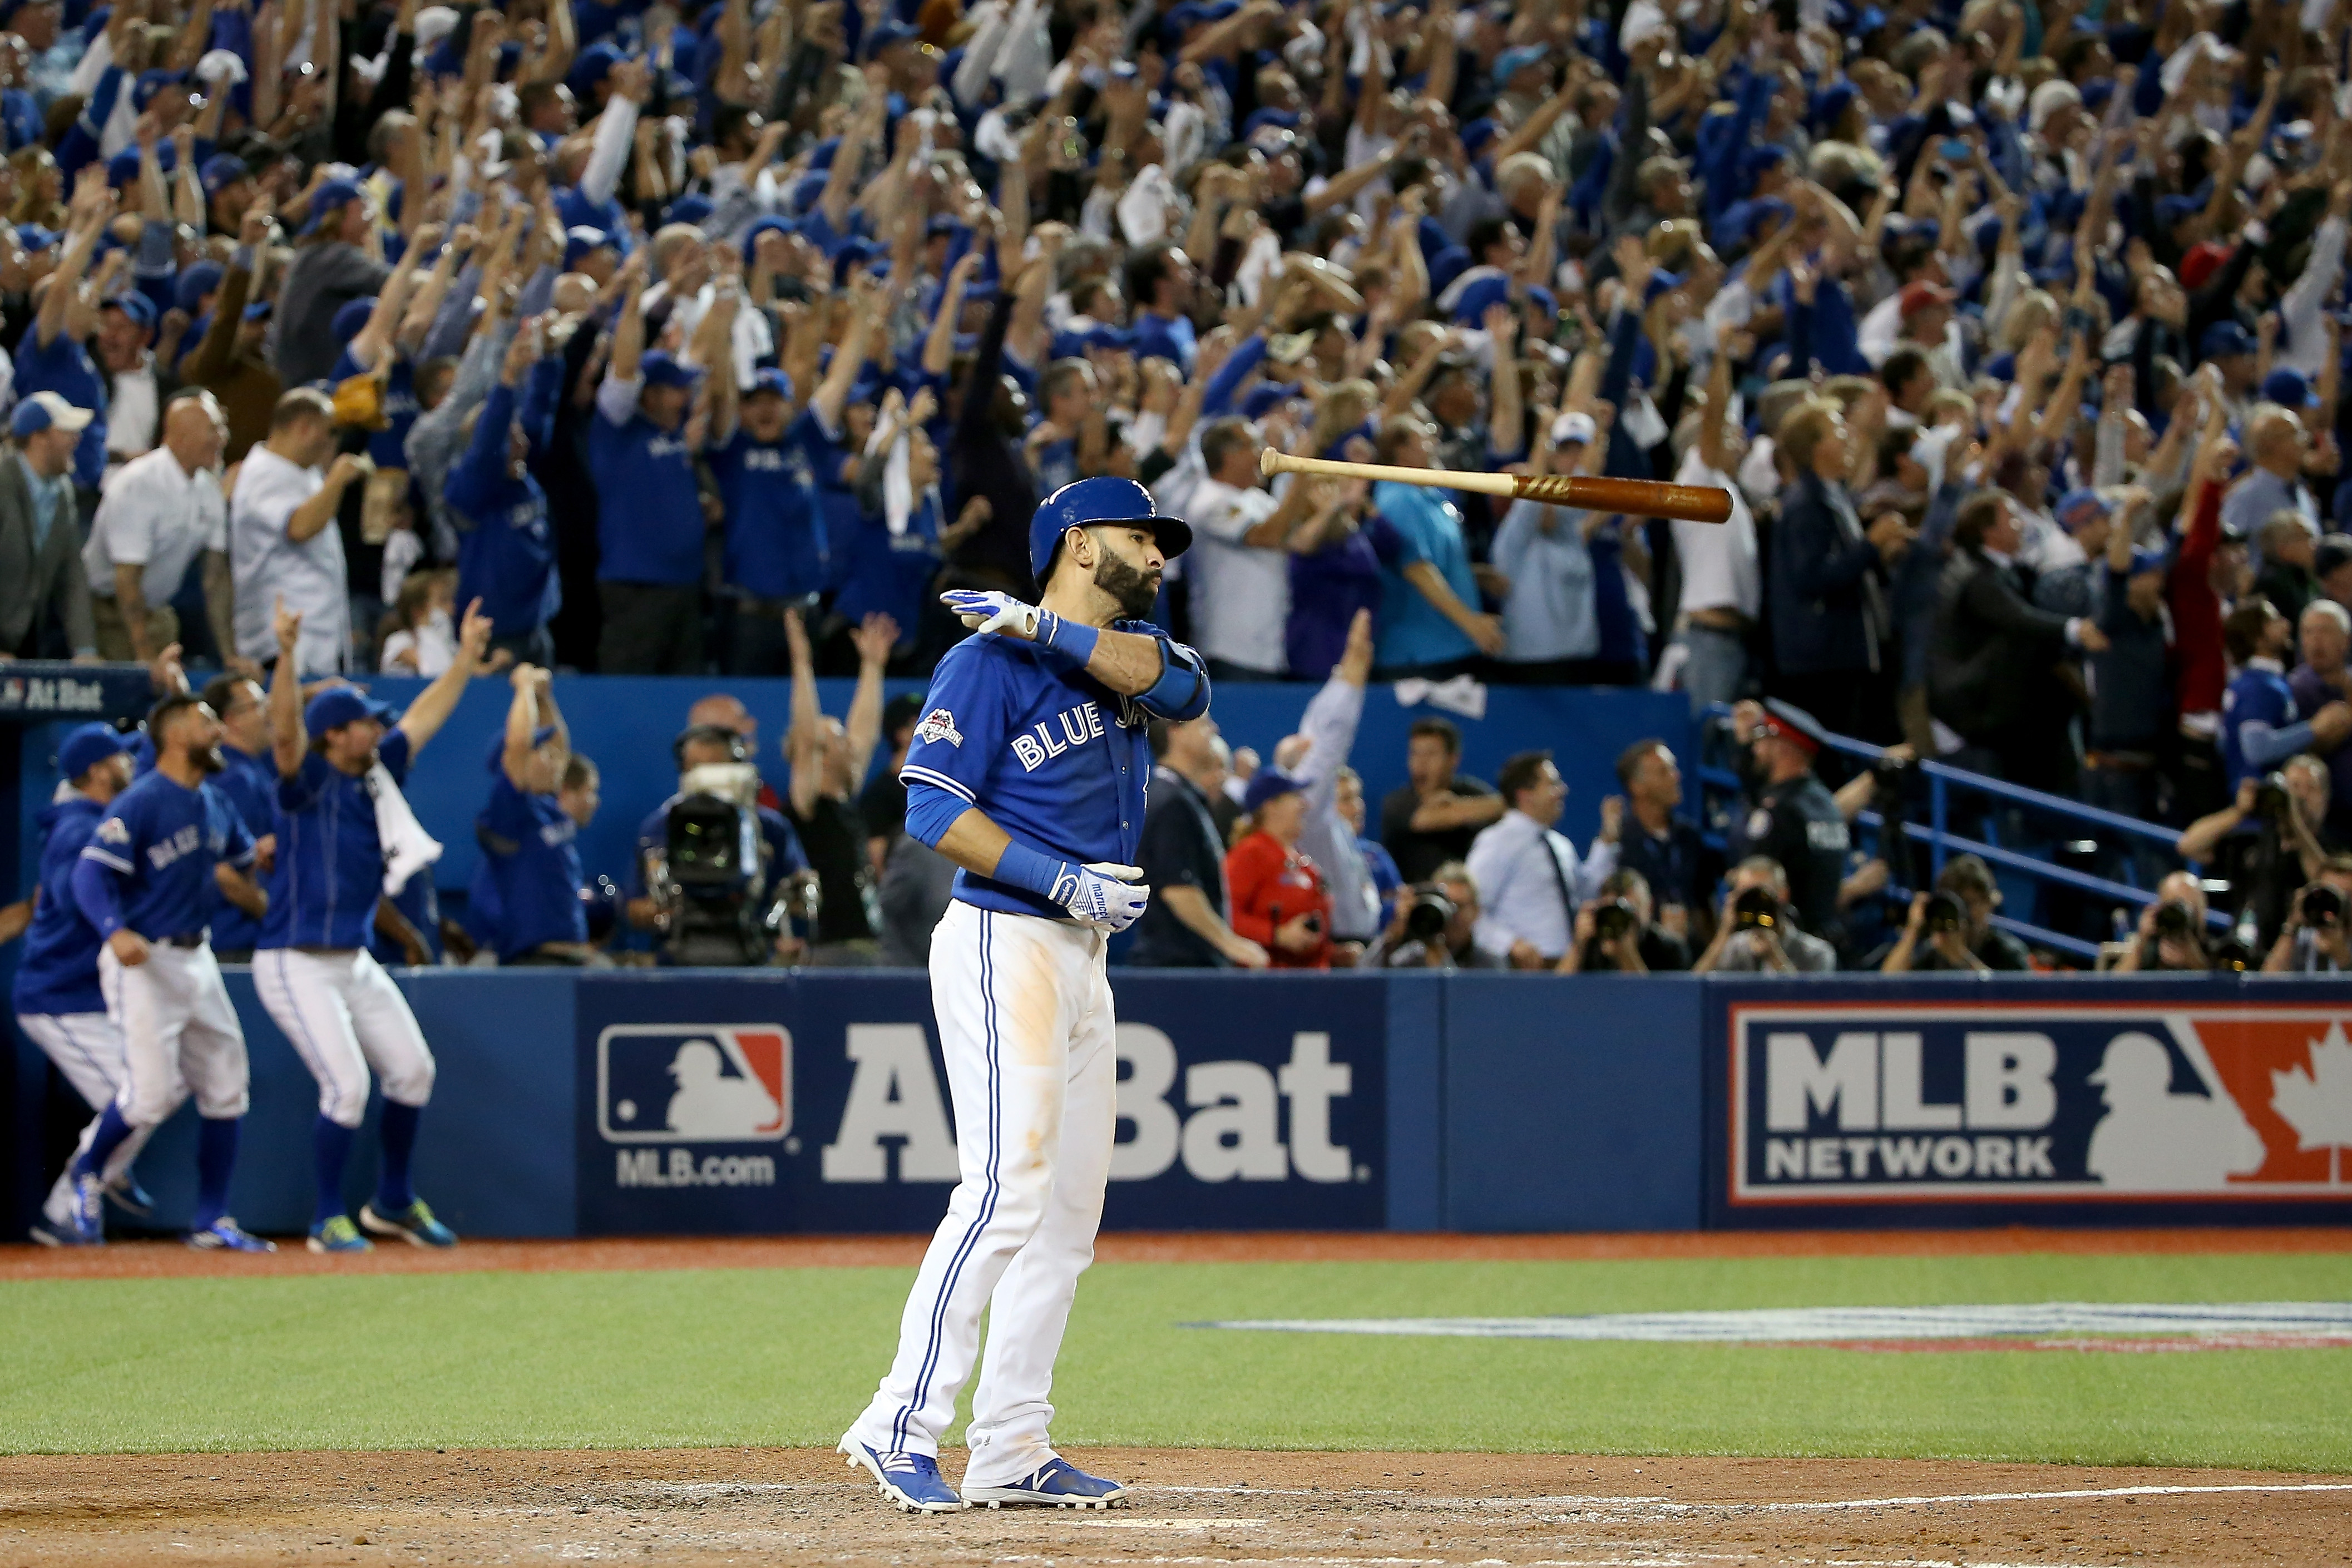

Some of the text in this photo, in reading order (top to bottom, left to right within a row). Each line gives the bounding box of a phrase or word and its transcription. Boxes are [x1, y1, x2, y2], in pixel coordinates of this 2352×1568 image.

[914, 723, 962, 745] TSEASON
[1010, 701, 1105, 773] BLUE
[1092, 883, 1110, 918] marucci
[821, 1021, 1353, 1184] A Bat
[1766, 1032, 2058, 1132] MLB
[615, 1148, 775, 1188] MLB.com
[1765, 1136, 2057, 1180] NETWORK
